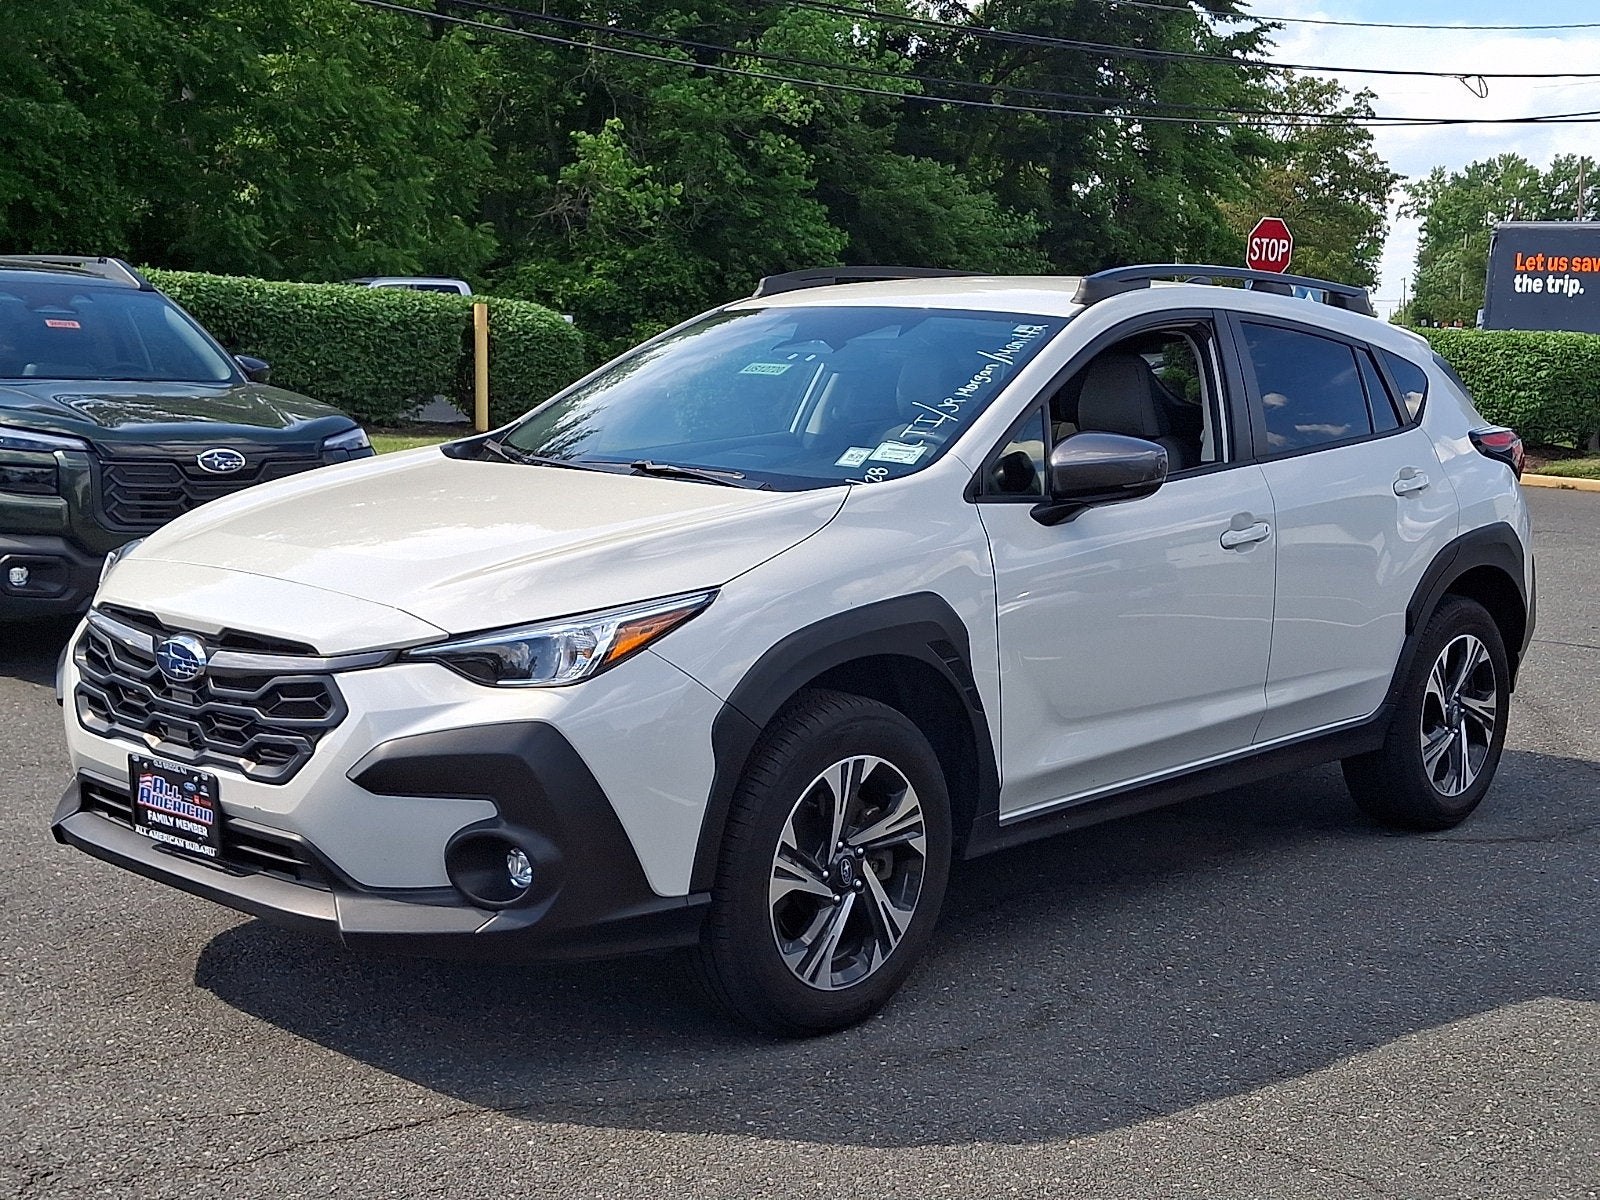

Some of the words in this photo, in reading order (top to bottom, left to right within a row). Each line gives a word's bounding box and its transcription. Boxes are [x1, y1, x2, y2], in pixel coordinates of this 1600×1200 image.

[1250, 237, 1289, 262] STOP
[1515, 252, 1544, 271] Let
[1547, 256, 1568, 272] us
[1513, 273, 1543, 293] the
[1546, 273, 1585, 298] trip.
[147, 810, 174, 827] FAMILY
[176, 818, 208, 837] MEMBER
